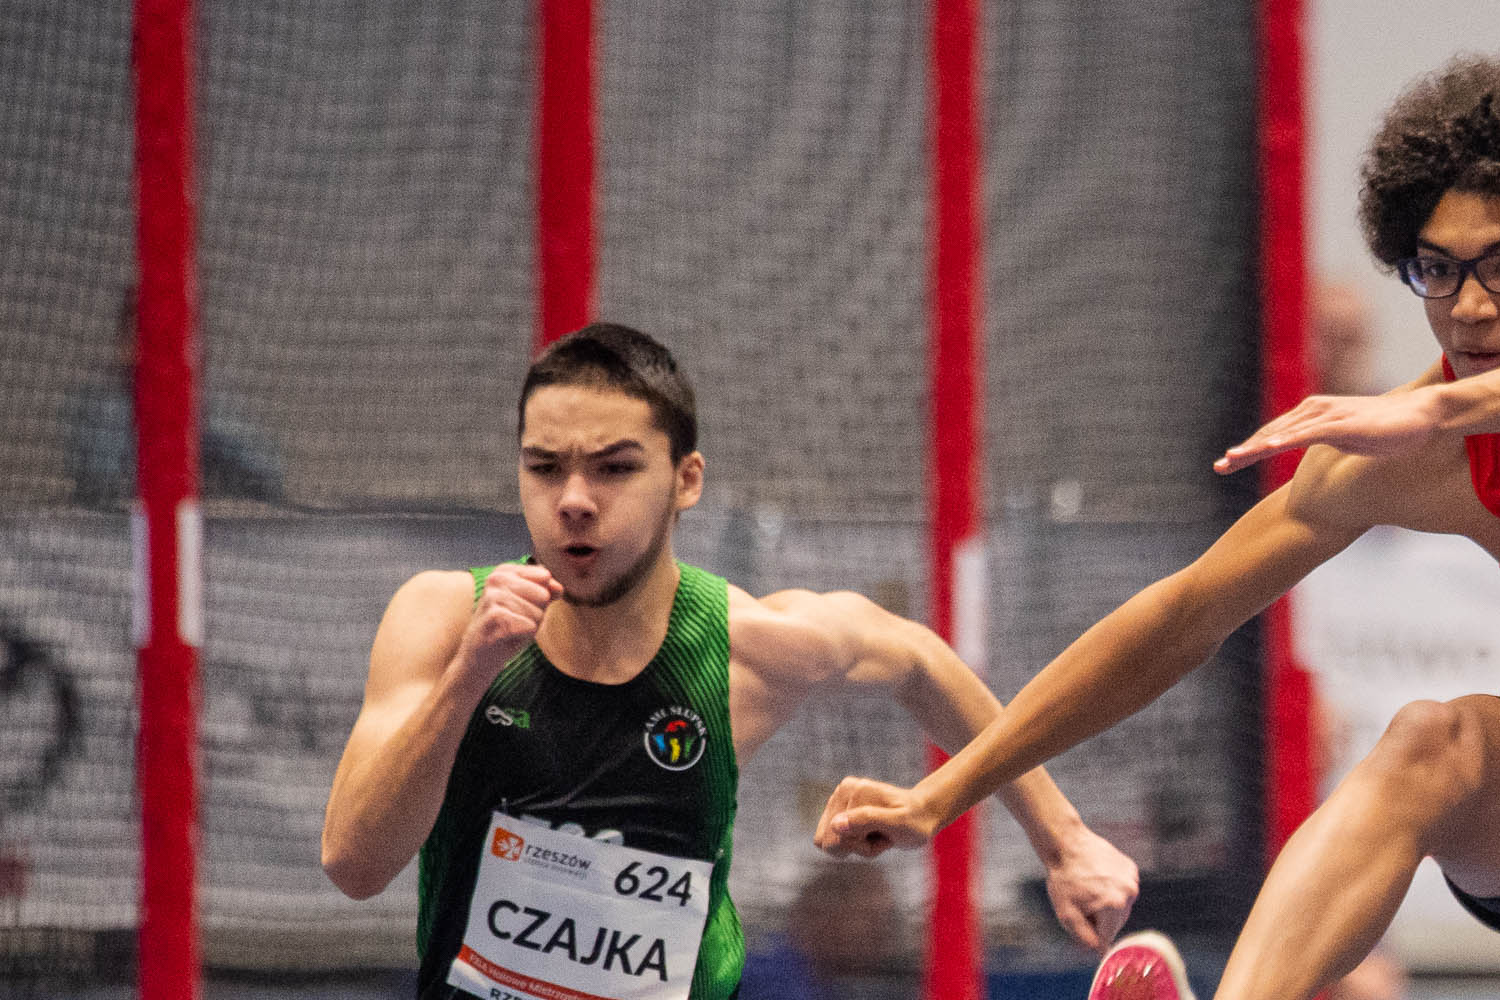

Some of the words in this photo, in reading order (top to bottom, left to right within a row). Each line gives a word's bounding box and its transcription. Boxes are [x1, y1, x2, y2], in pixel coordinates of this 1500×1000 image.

[525, 843, 592, 870] rzeszów
[614, 861, 692, 908] 624
[487, 899, 669, 982] CZAJKA
